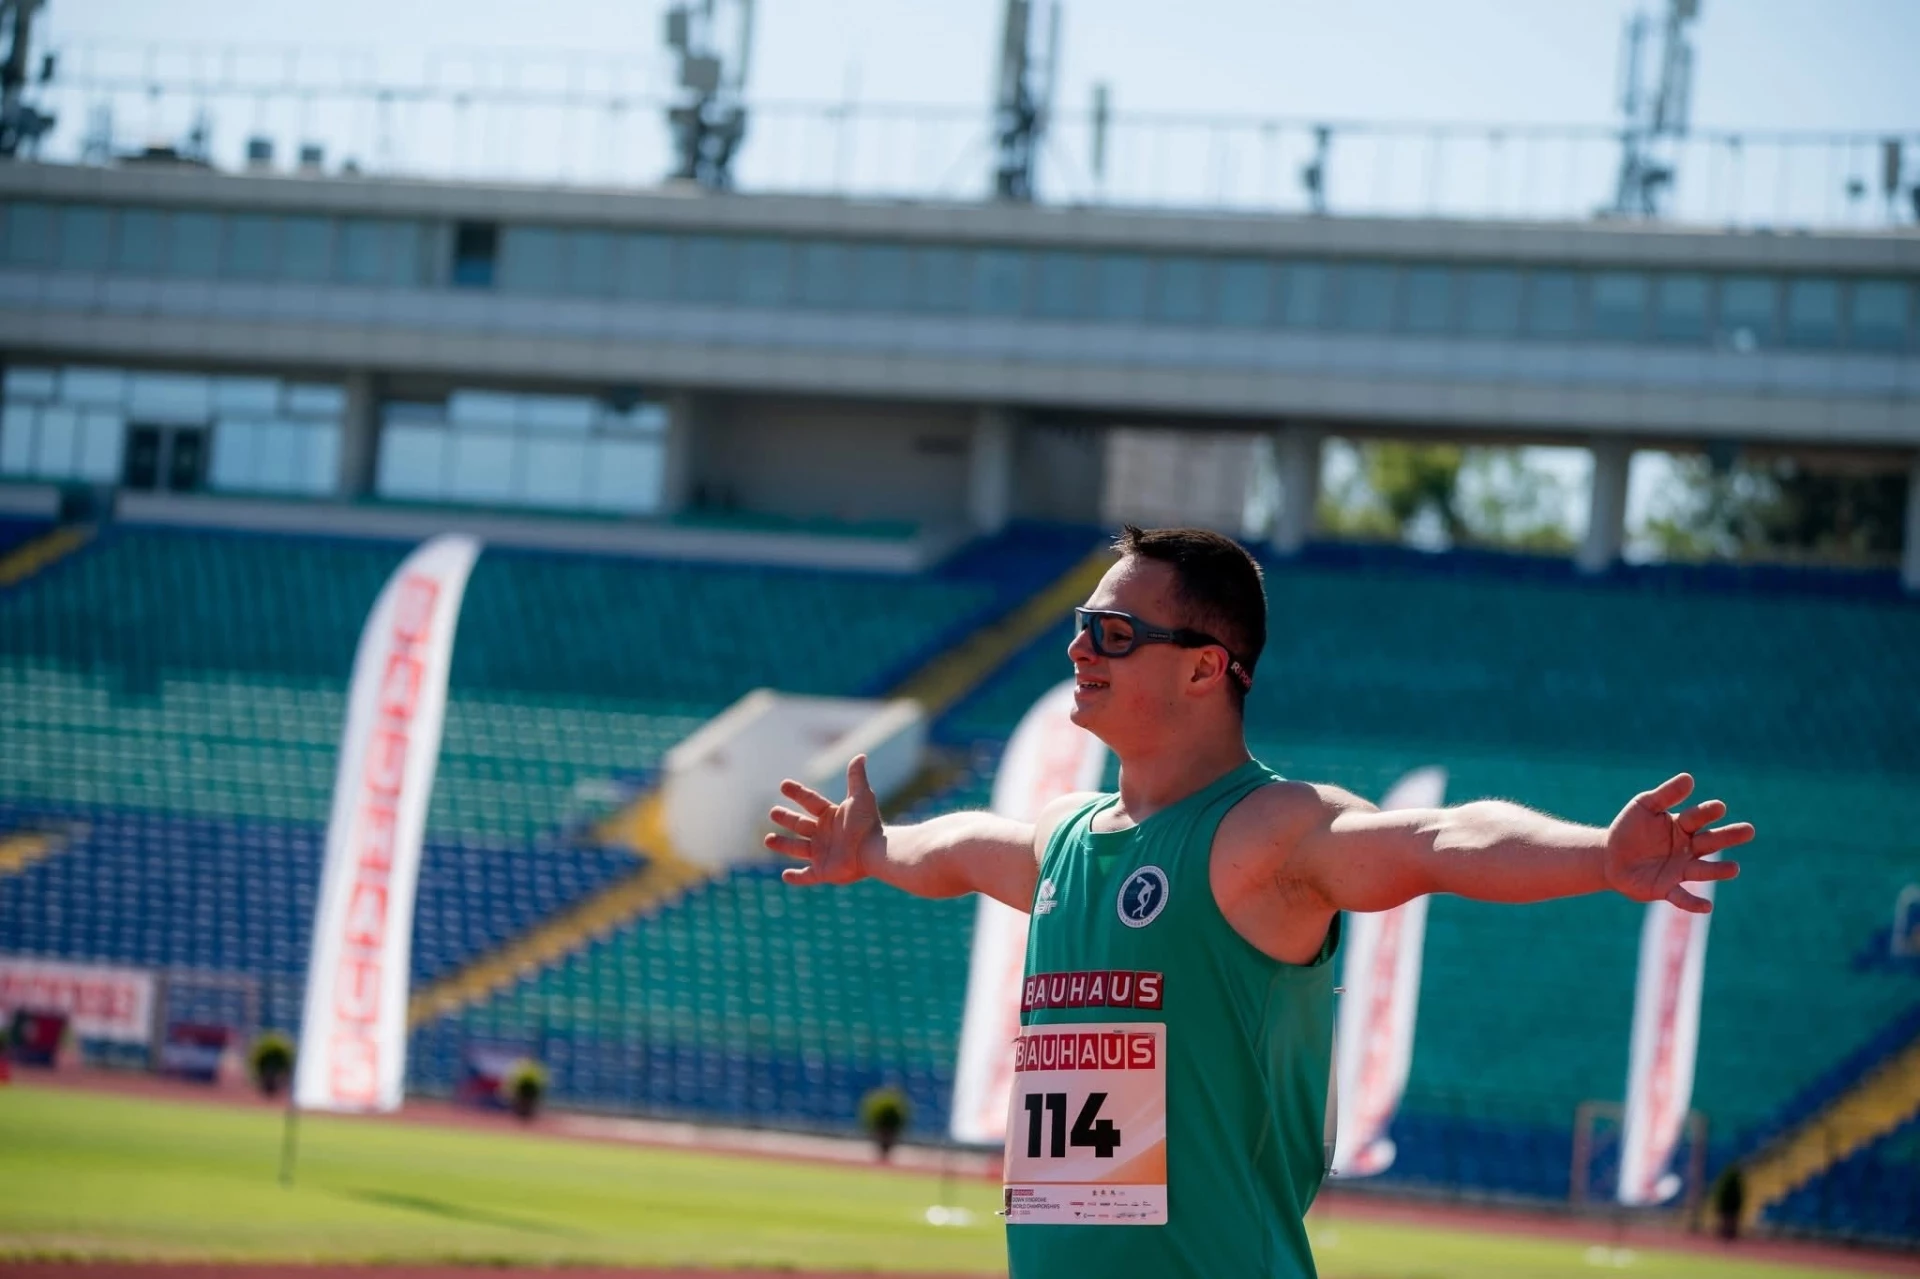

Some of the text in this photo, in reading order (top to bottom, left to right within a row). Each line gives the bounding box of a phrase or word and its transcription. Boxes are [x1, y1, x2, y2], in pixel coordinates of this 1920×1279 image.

[1025, 974, 1159, 1006] BAUHAUS
[1016, 1038, 1152, 1067] BAUHAUS
[1025, 1093, 1121, 1157] 114
